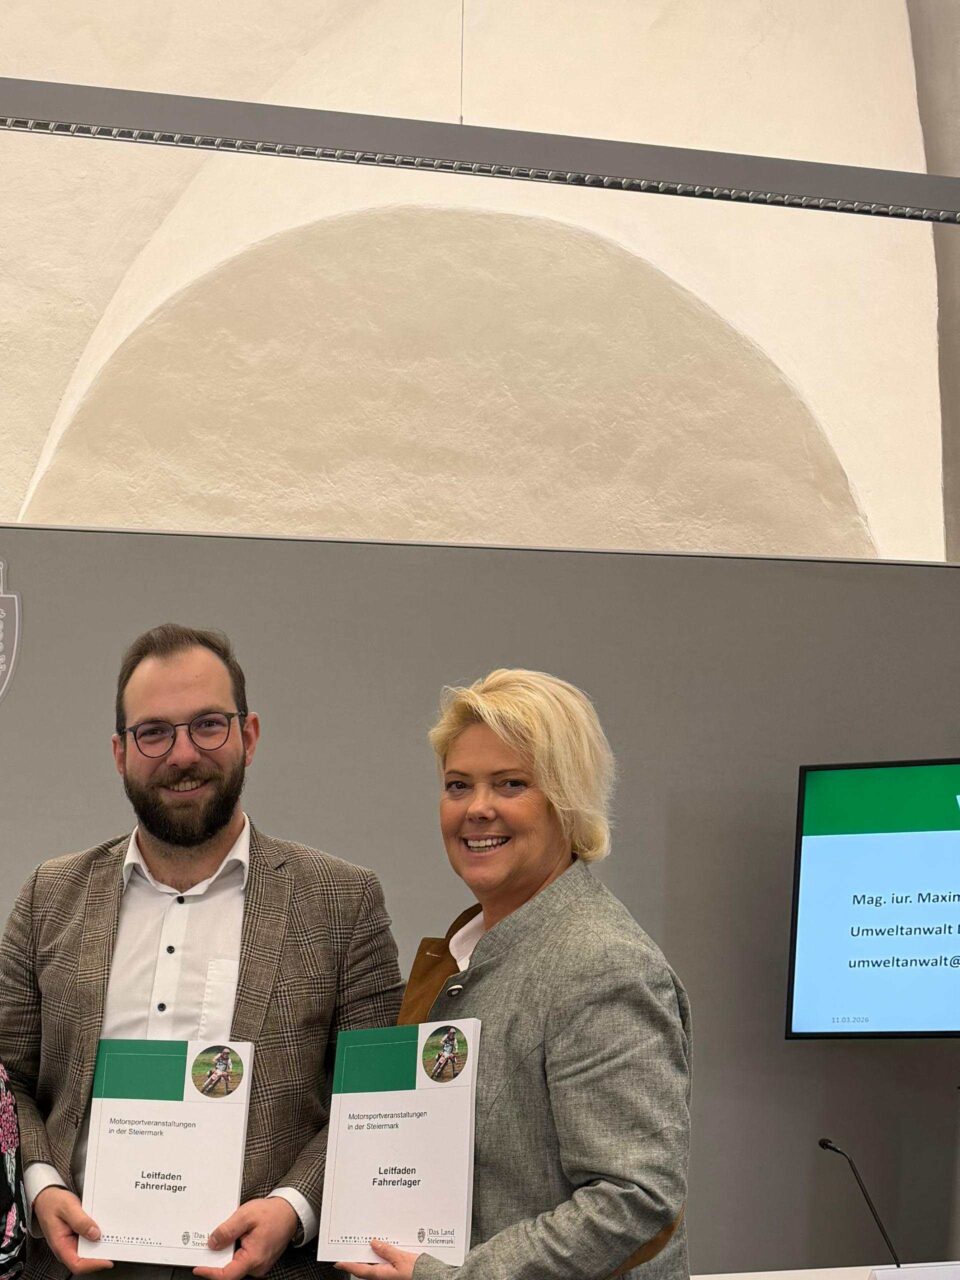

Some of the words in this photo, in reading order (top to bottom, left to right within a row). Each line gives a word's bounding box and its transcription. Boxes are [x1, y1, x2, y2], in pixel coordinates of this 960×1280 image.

[852, 893, 887, 907] Mag.
[891, 892, 913, 904] iur.
[850, 923, 953, 937] Umweltanwalt
[848, 955, 960, 969] umweltanwalt@
[348, 1111, 428, 1121] Motorsportveranstaltungen
[109, 1117, 196, 1129] Motorsportveranstaltungen
[366, 1122, 399, 1130] Steiermark
[128, 1128, 164, 1137] Steiermark
[141, 1170, 182, 1181] Leitfaden
[378, 1166, 416, 1175] Leitfaden
[134, 1181, 187, 1193] Fahrerlager
[372, 1177, 421, 1187] Fahrerlager
[440, 1228, 455, 1236] Land
